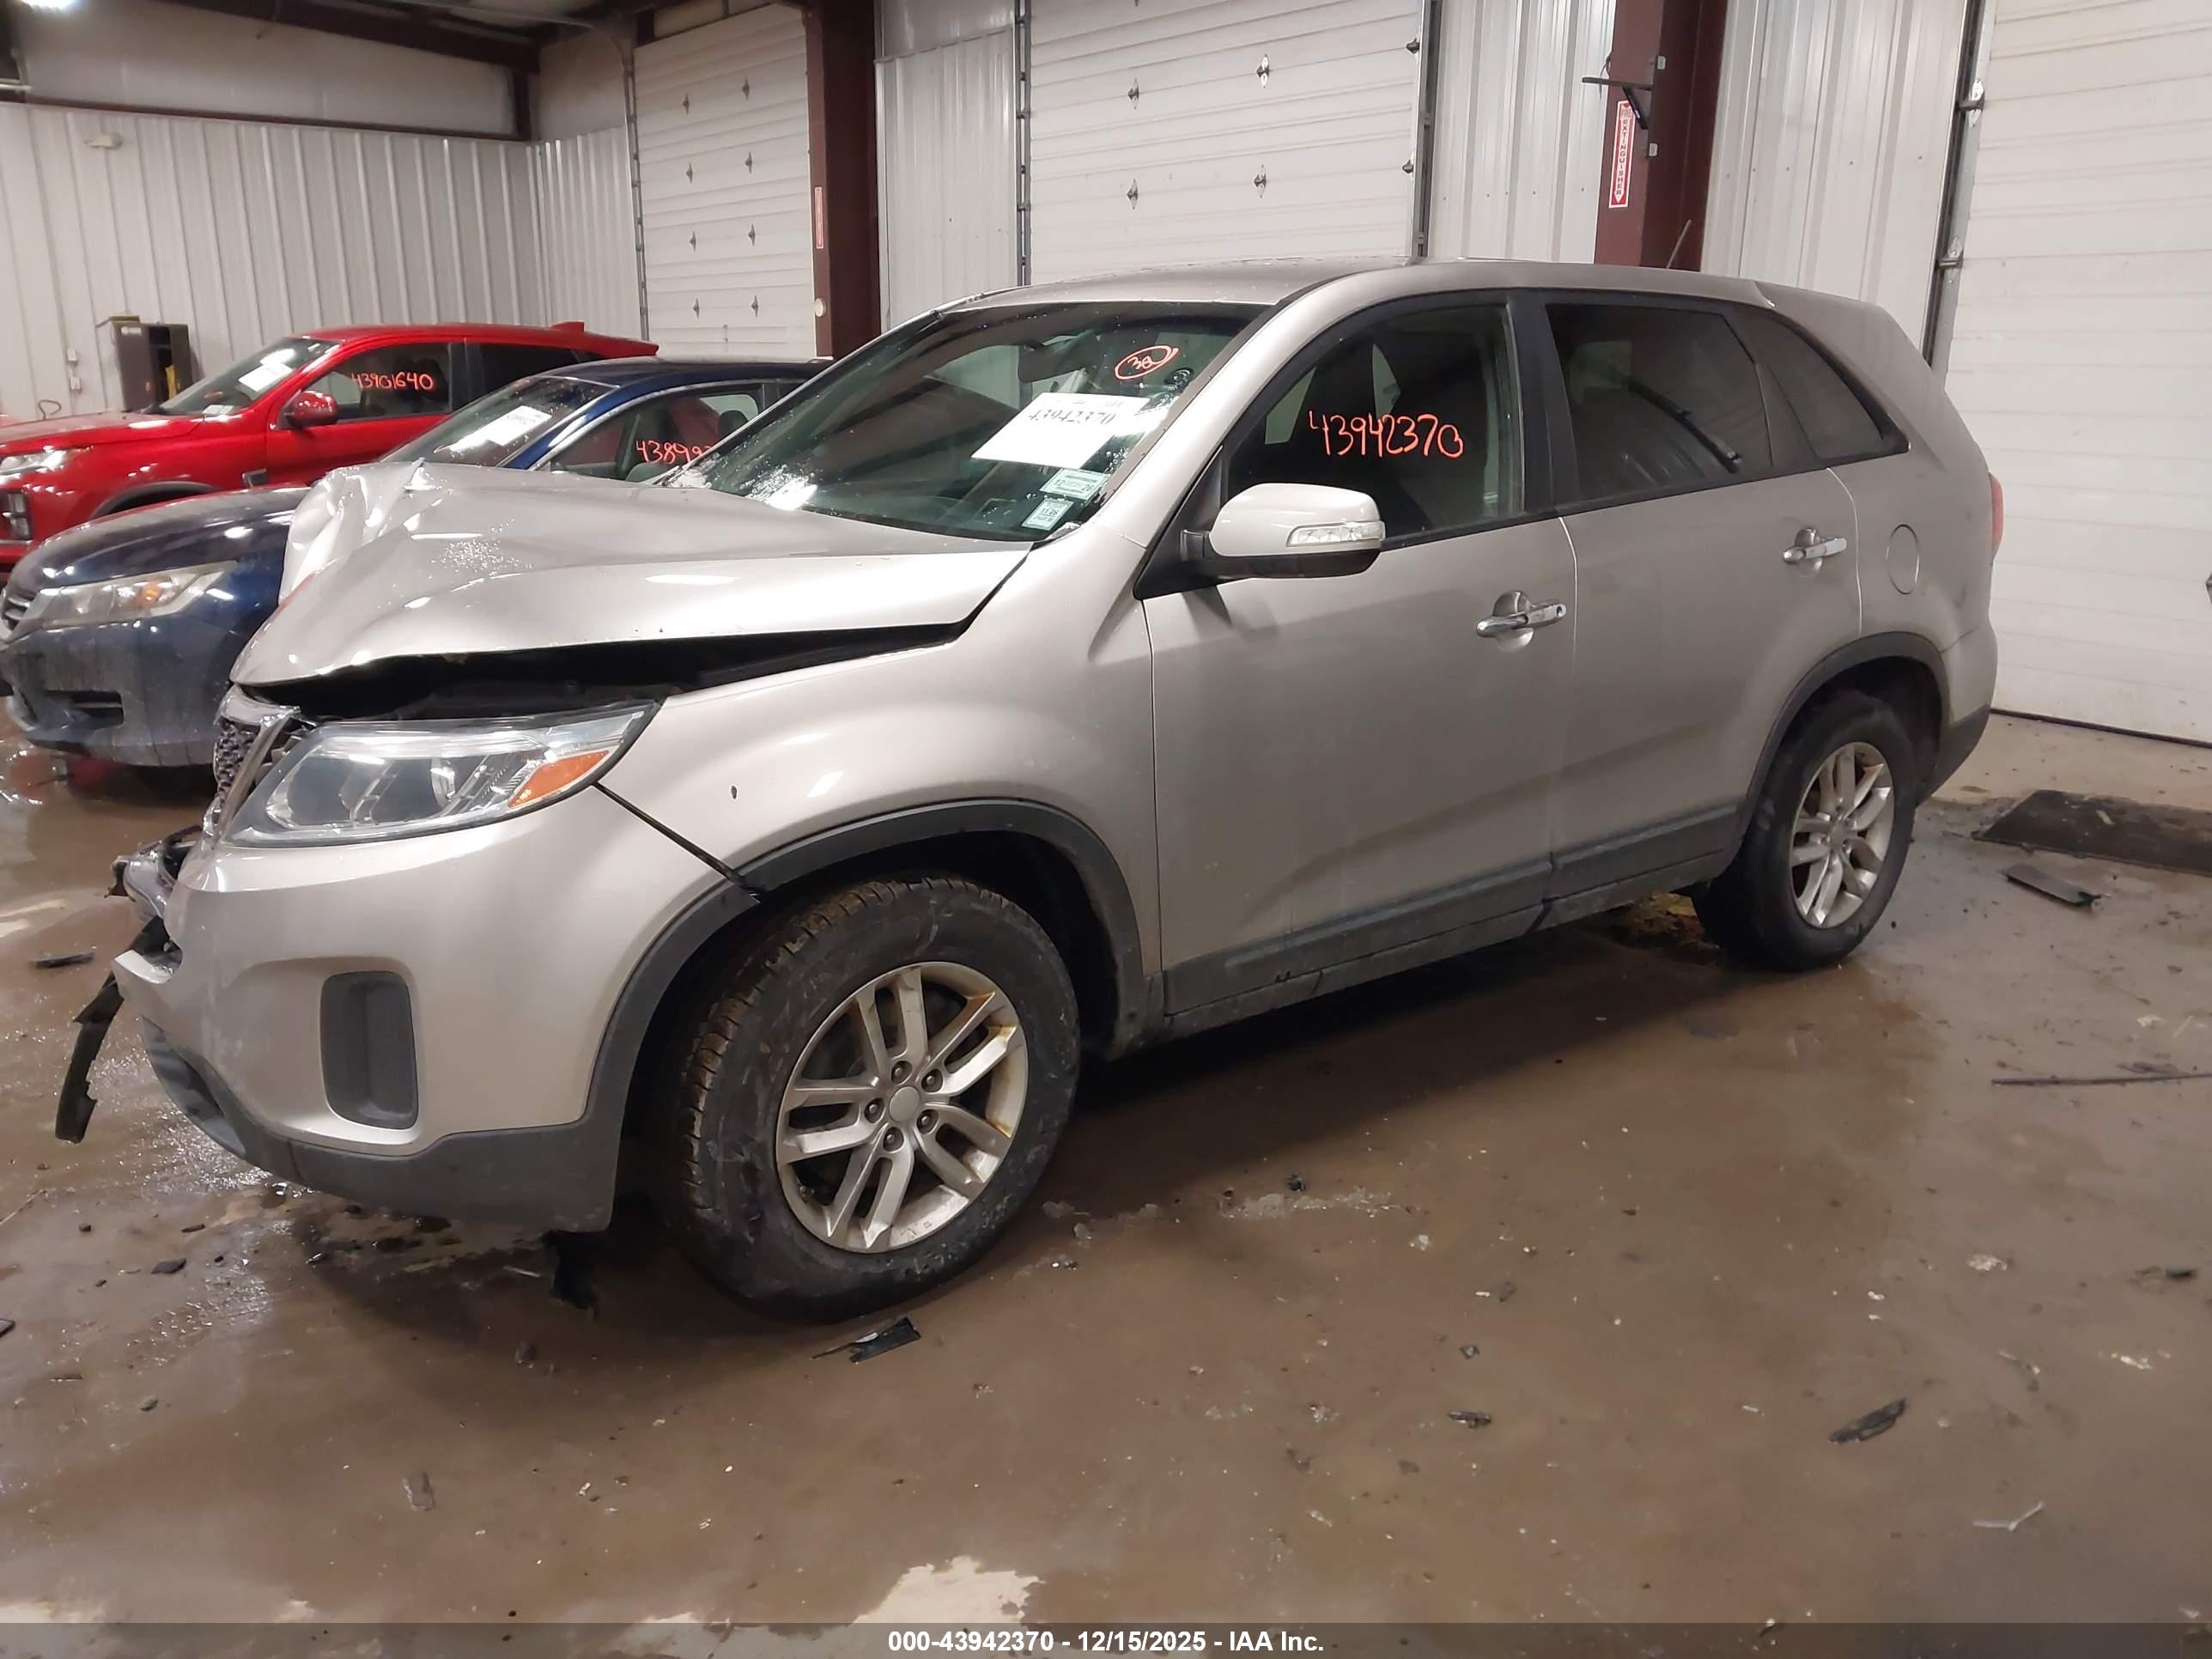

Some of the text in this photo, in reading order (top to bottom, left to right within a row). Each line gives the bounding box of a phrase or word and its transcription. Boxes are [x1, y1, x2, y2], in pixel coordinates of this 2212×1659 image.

[1616, 119, 1630, 196] EXTINGUISHER
[350, 371, 434, 391] 43901640
[635, 439, 712, 465] 43899
[1308, 410, 1464, 459] 43942370
